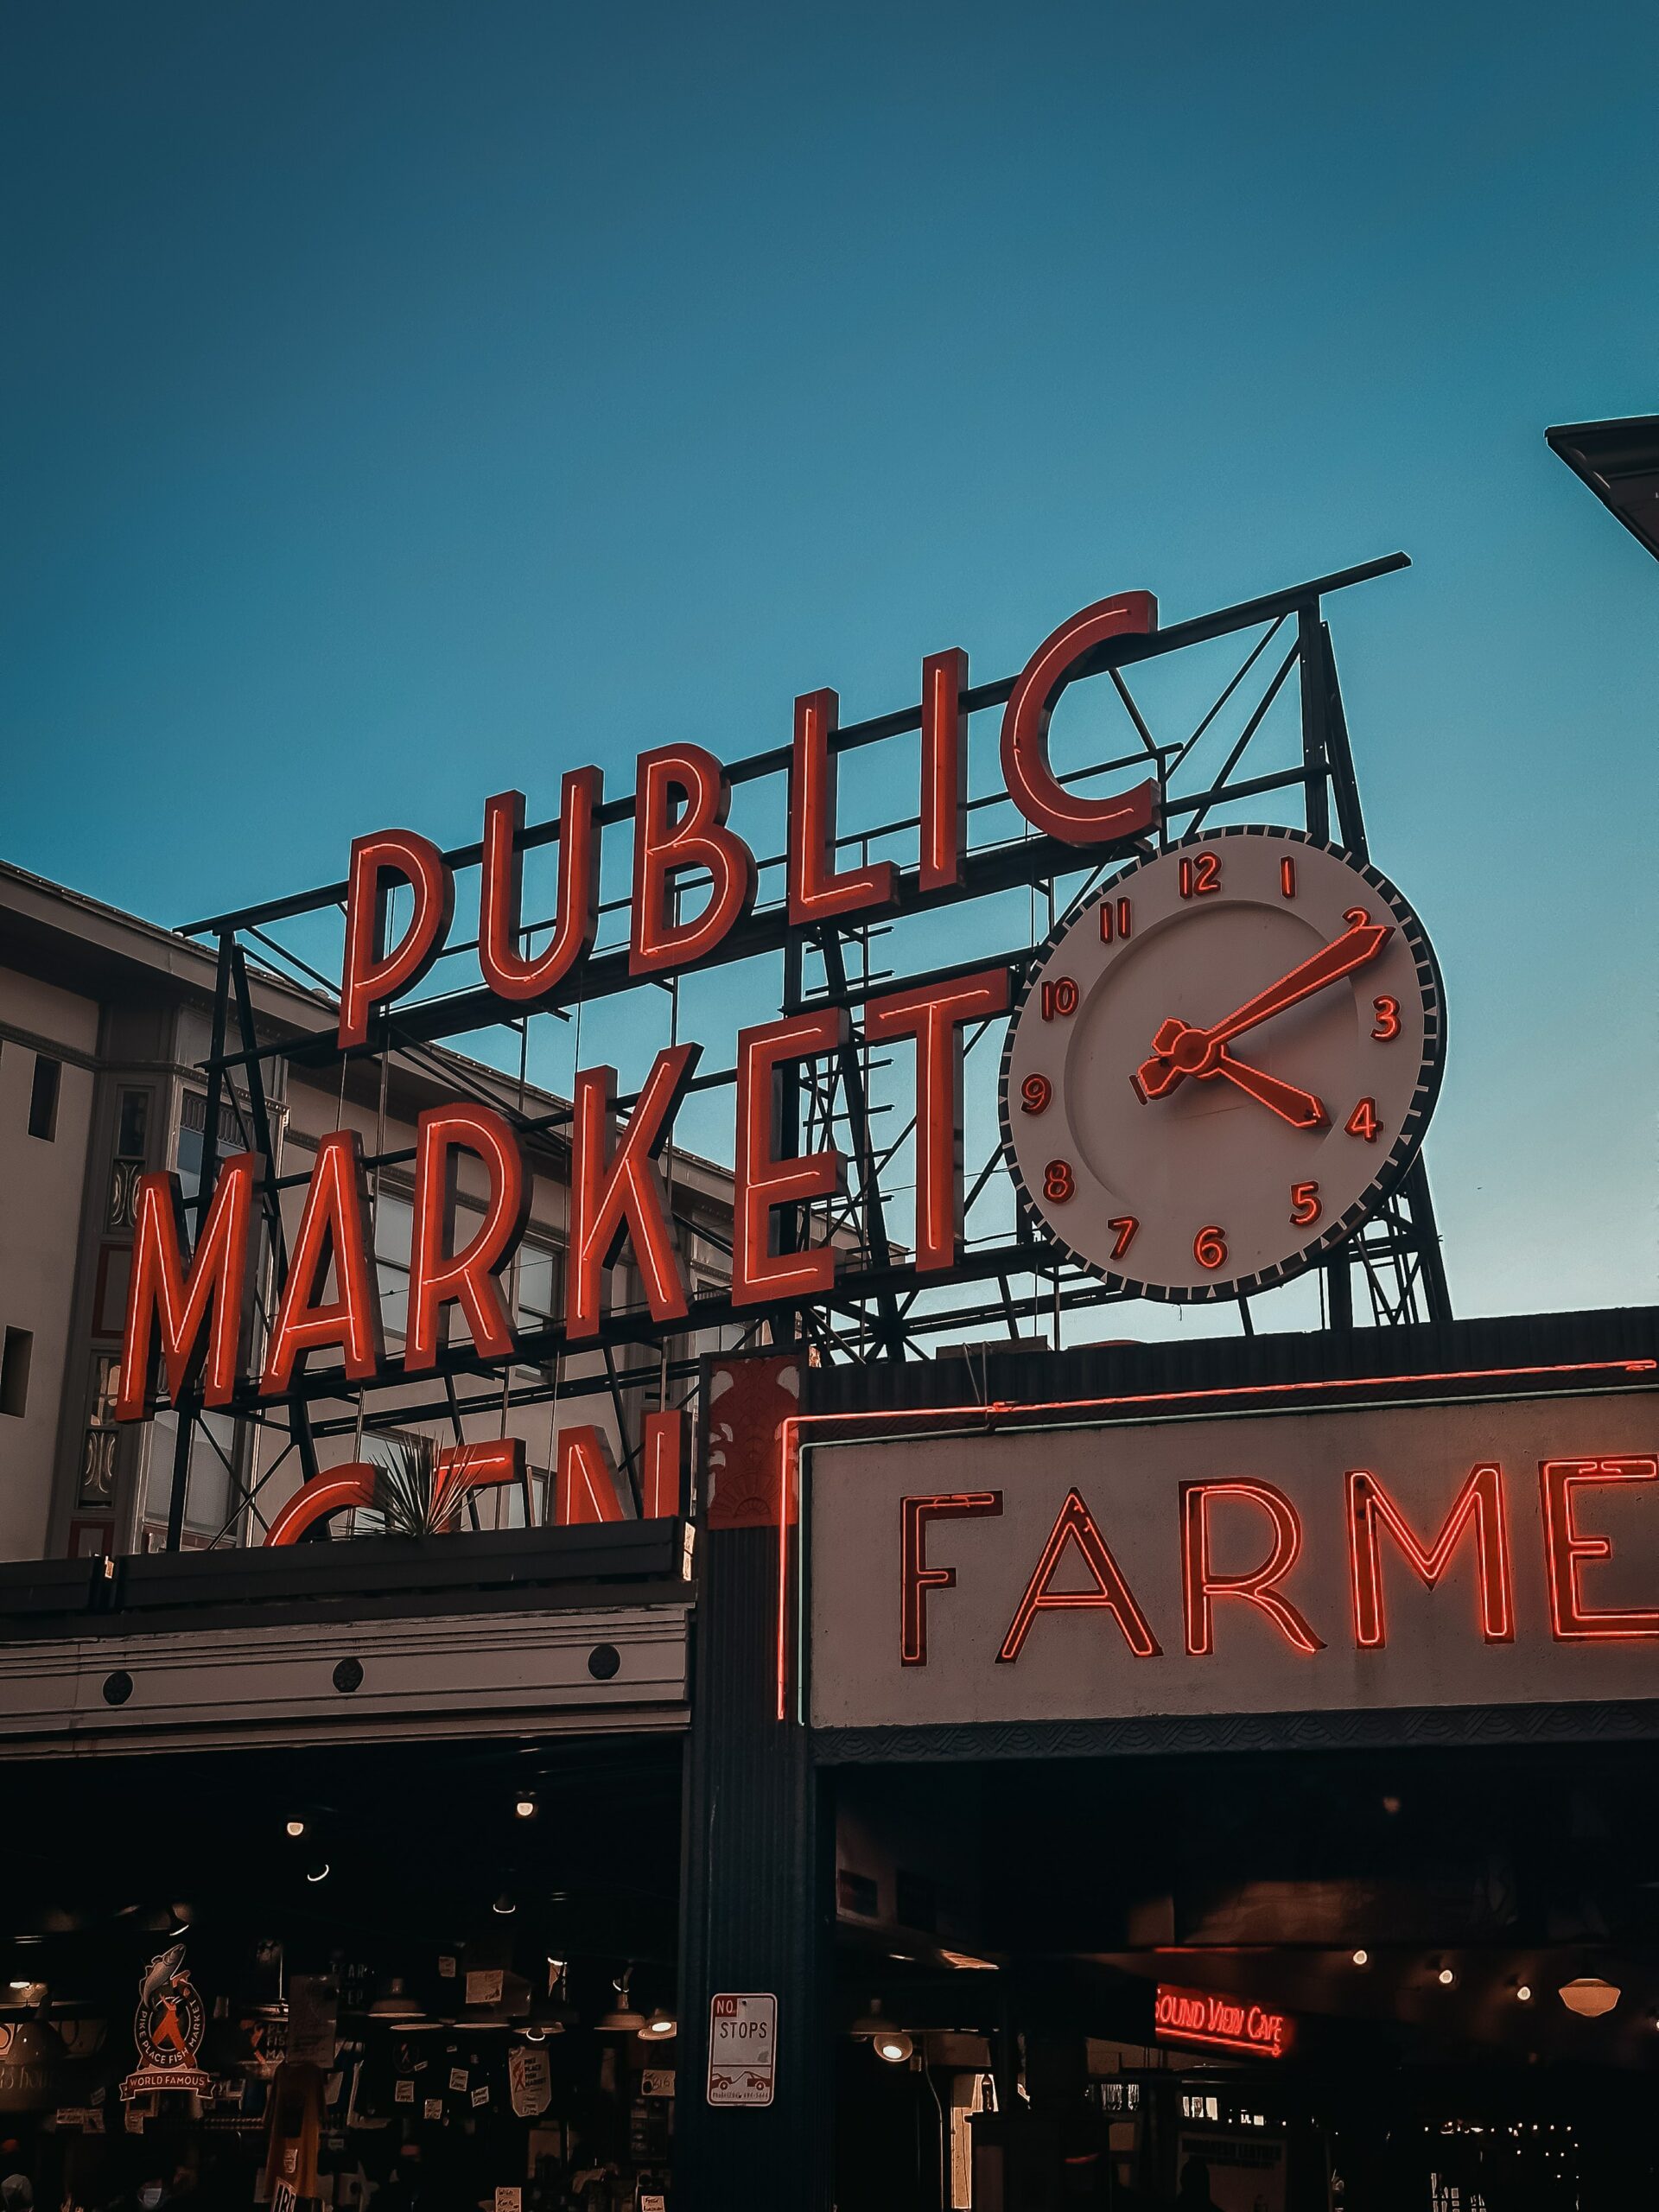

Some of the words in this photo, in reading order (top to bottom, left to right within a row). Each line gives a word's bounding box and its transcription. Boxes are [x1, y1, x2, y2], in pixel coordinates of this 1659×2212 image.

[338, 589, 1159, 1048] PUBLIC
[1179, 850, 1222, 899] 12
[1280, 855, 1296, 899] 1
[1099, 896, 1132, 944] 11
[1040, 976, 1080, 1021] 10
[1370, 994, 1402, 1041] 3
[1020, 1073, 1052, 1115] 9
[1344, 1096, 1383, 1142] 4
[115, 968, 1013, 1423] MARKET
[1043, 1159, 1075, 1203] 8
[1289, 1180, 1322, 1225] 5
[1107, 1215, 1140, 1260] 7
[1193, 1225, 1228, 1268] 6
[899, 1453, 1659, 1666] FARME
[139, 2010, 148, 2038] PIKE
[188, 1998, 201, 2048] MARKET
[716, 1999, 734, 2014] NO
[720, 2021, 767, 2039] STOPS
[142, 2042, 167, 2064] PLACE
[168, 2047, 189, 2064] FISH
[130, 2075, 163, 2088] WORLD
[164, 2075, 206, 2087] FAMOUS
